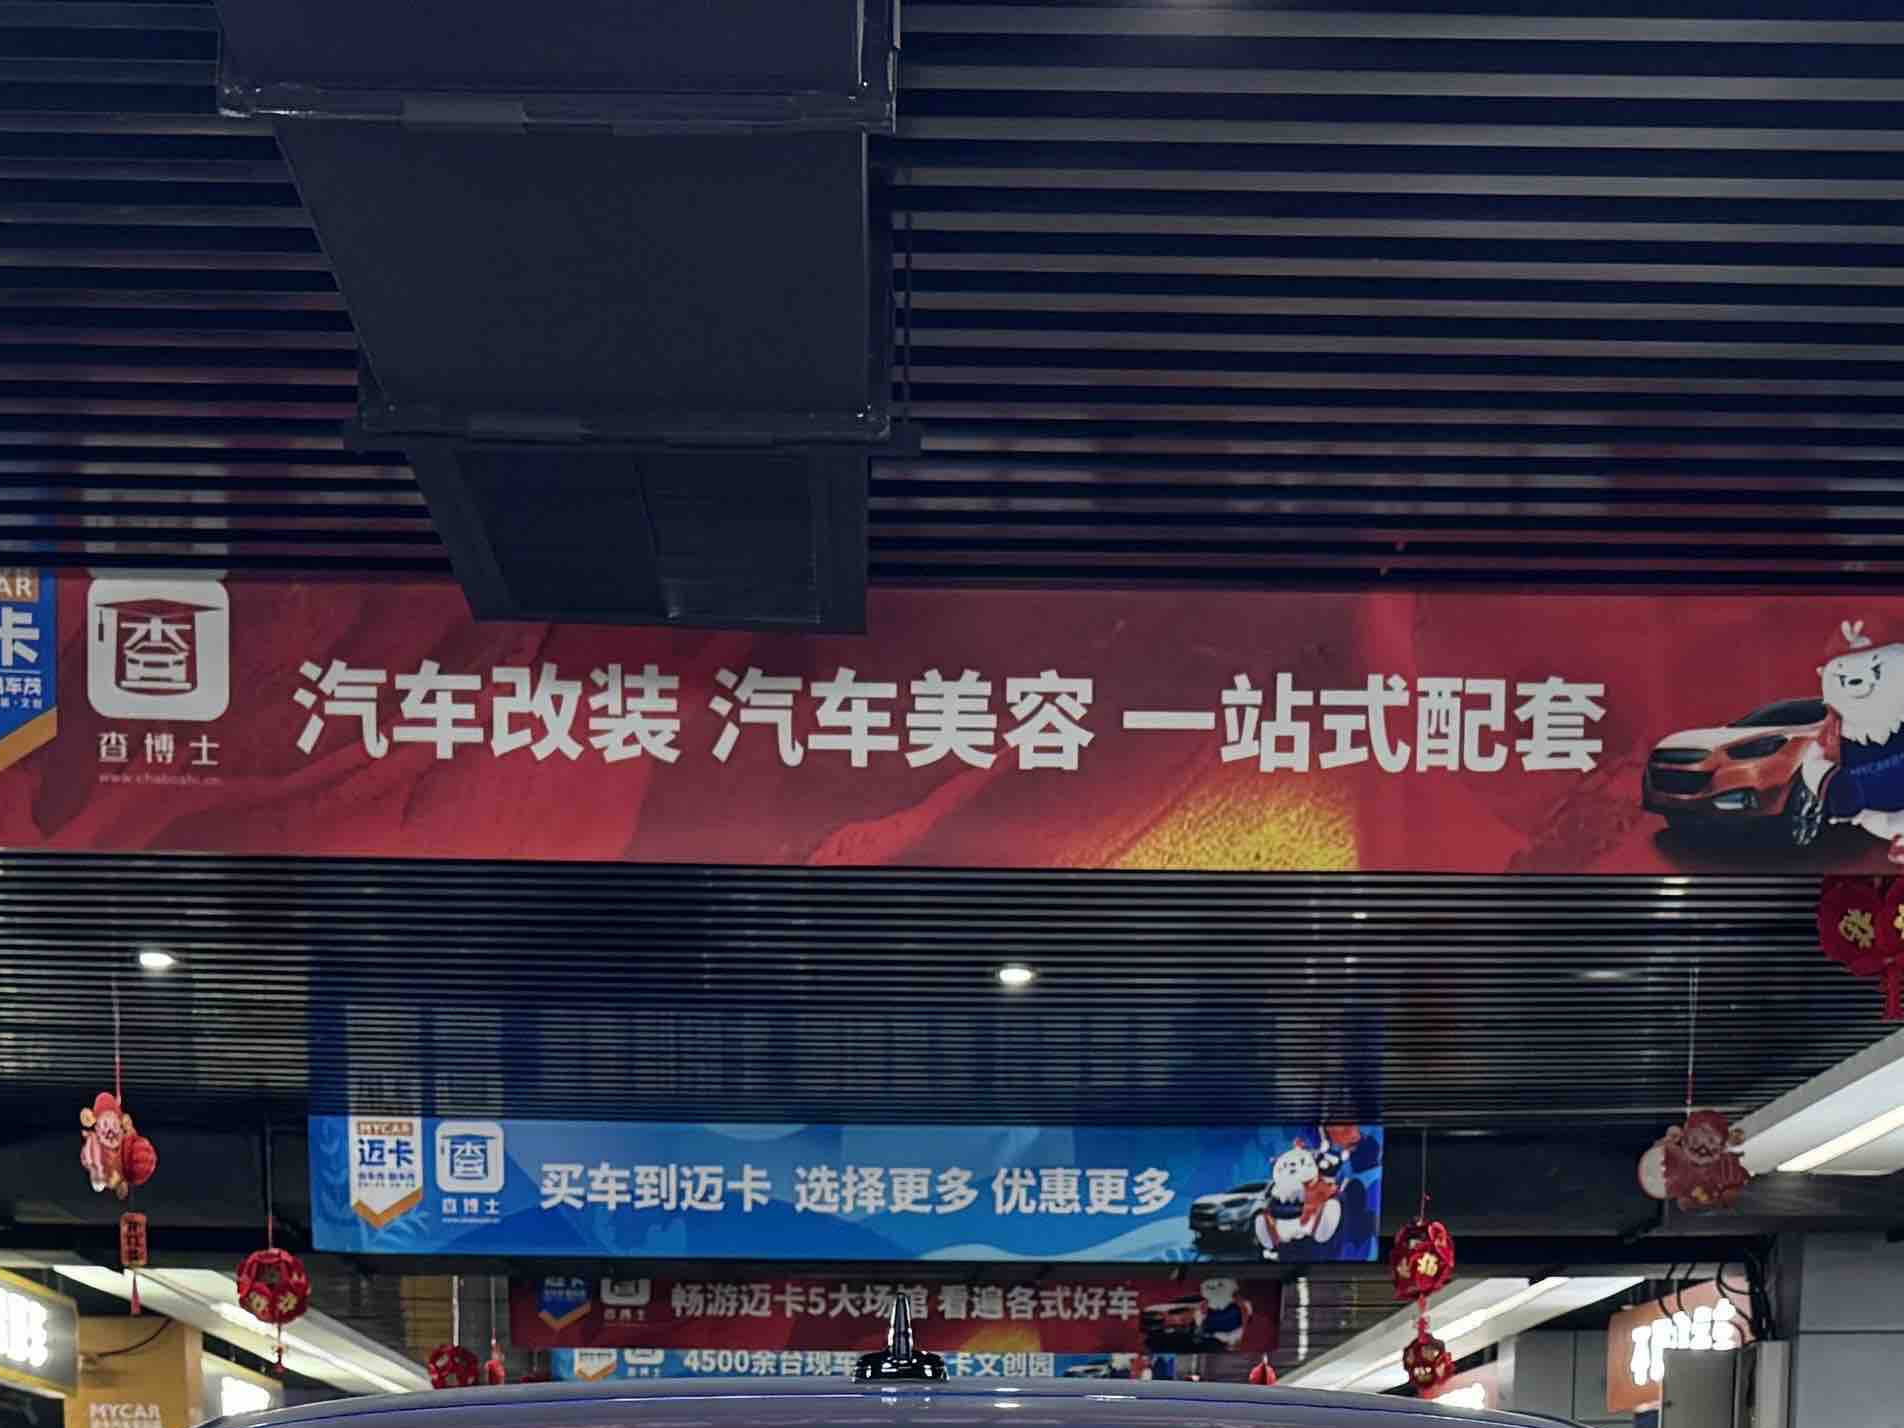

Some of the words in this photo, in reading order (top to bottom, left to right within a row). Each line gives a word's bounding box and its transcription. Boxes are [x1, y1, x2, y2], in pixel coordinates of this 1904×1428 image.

[294, 660, 681, 764] 汽车改装
[709, 664, 1096, 772] 汽车美容
[1122, 671, 1606, 775] 一站式配套
[98, 730, 221, 766] 查博士
[358, 1138, 415, 1168] 迈卡
[539, 1162, 772, 1213] 买车到迈卡
[794, 1165, 979, 1216] 选择更多
[991, 1166, 1176, 1216] 优惠更多
[938, 1285, 1140, 1321] 看遍各式好车
[946, 1352, 1056, 1377] 卡文创园
